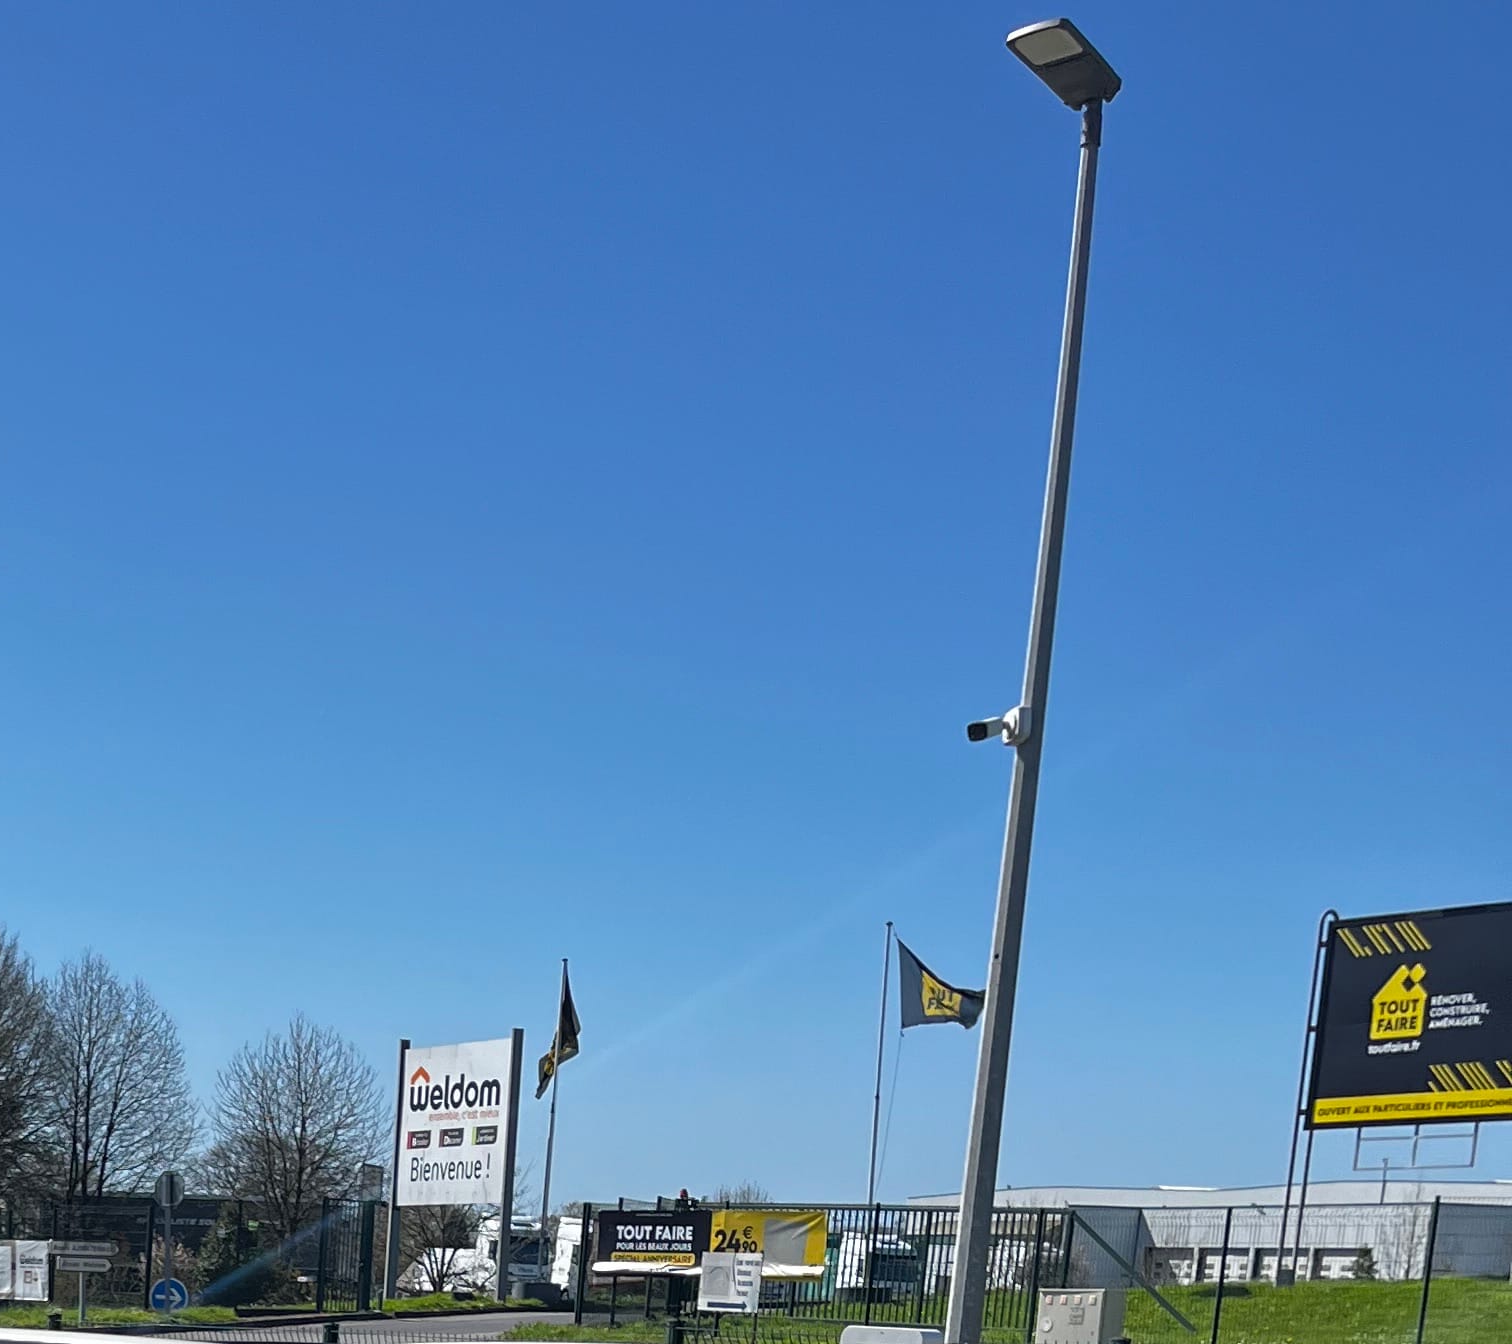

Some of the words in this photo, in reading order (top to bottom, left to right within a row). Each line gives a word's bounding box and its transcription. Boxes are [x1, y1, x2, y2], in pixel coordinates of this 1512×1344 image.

[1379, 999, 1419, 1015] TOUT
[1376, 1016, 1418, 1033] FAIRE
[410, 1073, 501, 1112] weldom
[410, 1157, 482, 1182] Bienvenue
[616, 1225, 653, 1240] TOUT
[655, 1226, 694, 1241] FAIRE
[713, 1229, 741, 1253] 24
[616, 1242, 634, 1250] POUR
[635, 1242, 647, 1250] LES
[648, 1242, 669, 1251] BEAUX
[669, 1242, 692, 1251] JOURS
